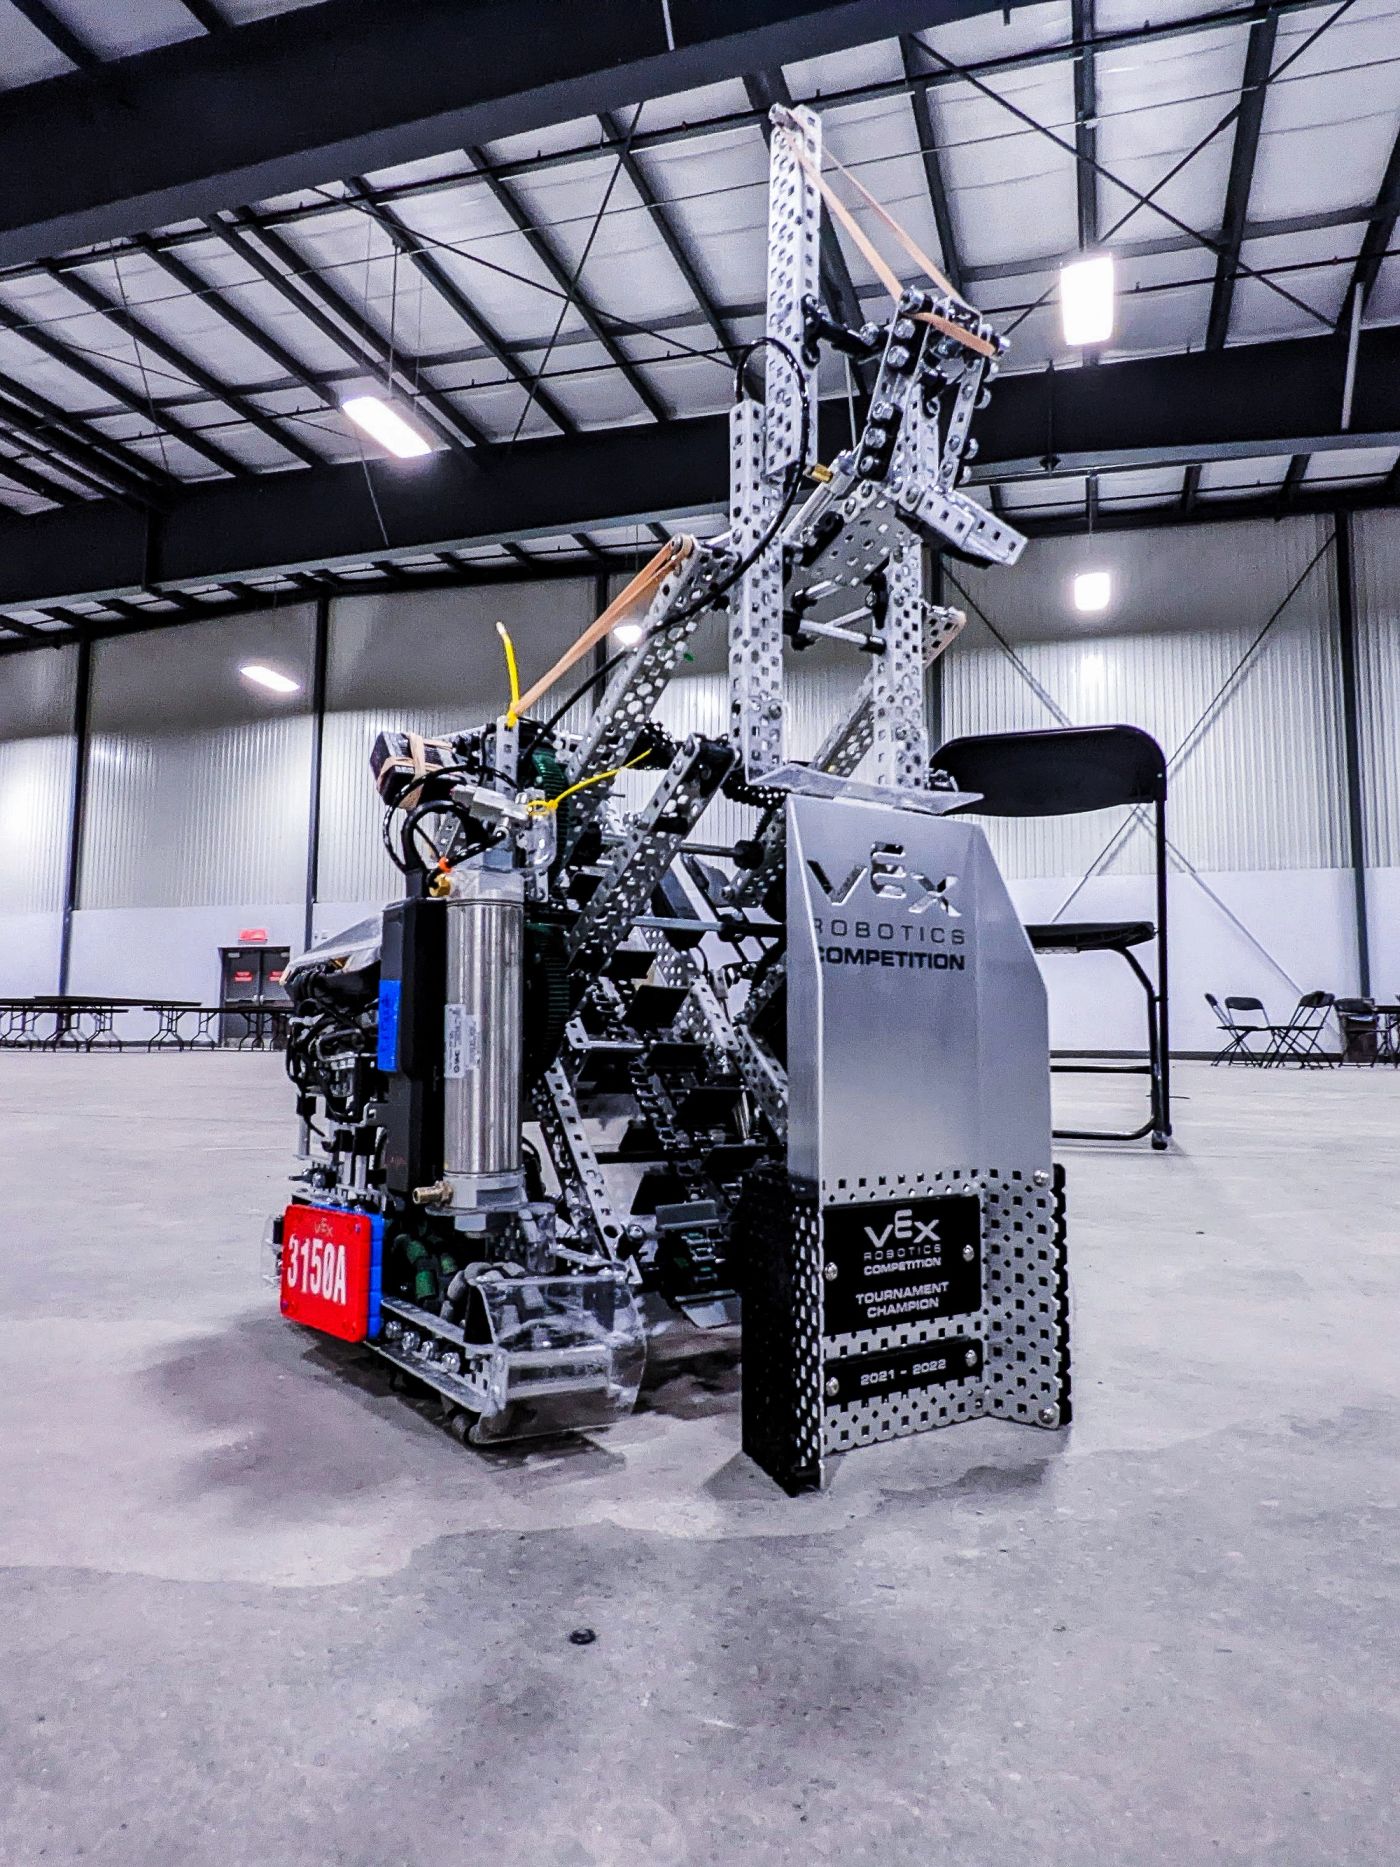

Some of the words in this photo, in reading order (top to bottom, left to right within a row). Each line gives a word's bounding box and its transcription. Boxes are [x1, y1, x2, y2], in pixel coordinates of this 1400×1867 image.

[807, 841, 961, 917] VEX
[813, 918, 965, 945] ROBOTICS
[864, 1209, 941, 1248] VEX
[864, 1244, 941, 1261] ROBOTICS
[287, 1233, 346, 1306] 3150A
[864, 1257, 941, 1276] COMPETITION
[856, 1281, 949, 1305] TOURNAMENT
[867, 1297, 939, 1318] CHAMPION
[861, 1369, 895, 1386] 2021
[912, 1359, 946, 1376] 2022
